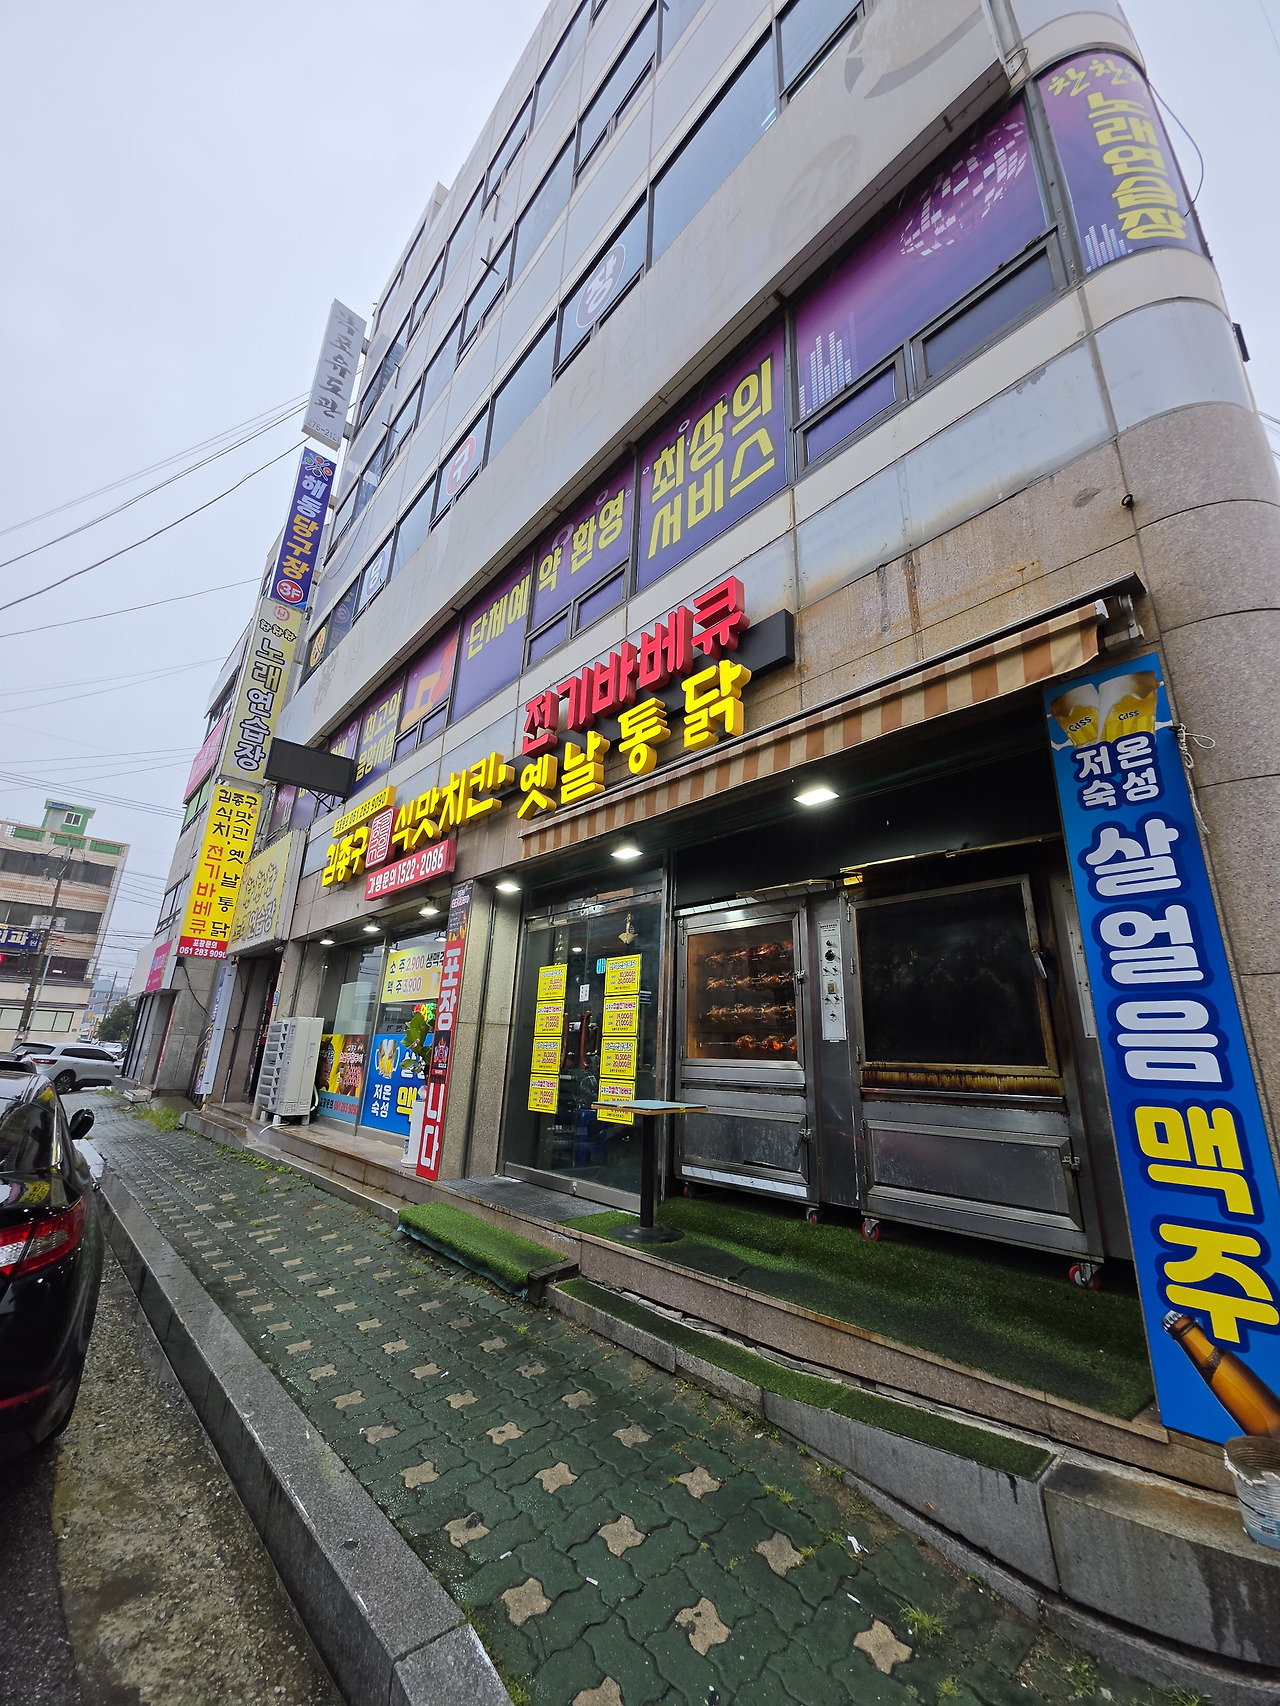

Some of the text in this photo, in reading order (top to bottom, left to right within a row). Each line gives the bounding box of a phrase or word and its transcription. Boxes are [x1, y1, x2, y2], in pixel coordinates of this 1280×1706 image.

[1087, 91, 1187, 240] 노래연습장
[452, 443, 471, 482] 구
[585, 254, 617, 314] 장
[651, 357, 773, 504] 최상의
[282, 475, 328, 580] 해동당구장
[570, 489, 625, 575] 환영
[648, 428, 775, 560] 서비스
[279, 582, 302, 600] 3F
[234, 638, 286, 772] 노래연습장
[522, 575, 748, 757] 전기바베큐
[218, 789, 258, 809] 김종구
[1076, 735, 1153, 779] 저온
[1082, 767, 1160, 807] 숙성
[215, 806, 254, 826] 식맛
[322, 826, 370, 887] 김종구
[190, 844, 224, 935] 전기바베큐
[210, 848, 245, 938] 옛날통닭
[367, 871, 396, 894] 가맹문의
[179, 946, 194, 955] 061
[194, 947, 208, 957] 283
[405, 955, 425, 972] 2,900
[1085, 818, 1223, 1084] 살얼음
[371, 1101, 390, 1119] 숙성
[373, 1083, 392, 1101] 저온
[1133, 1105, 1280, 1345] 맥주
